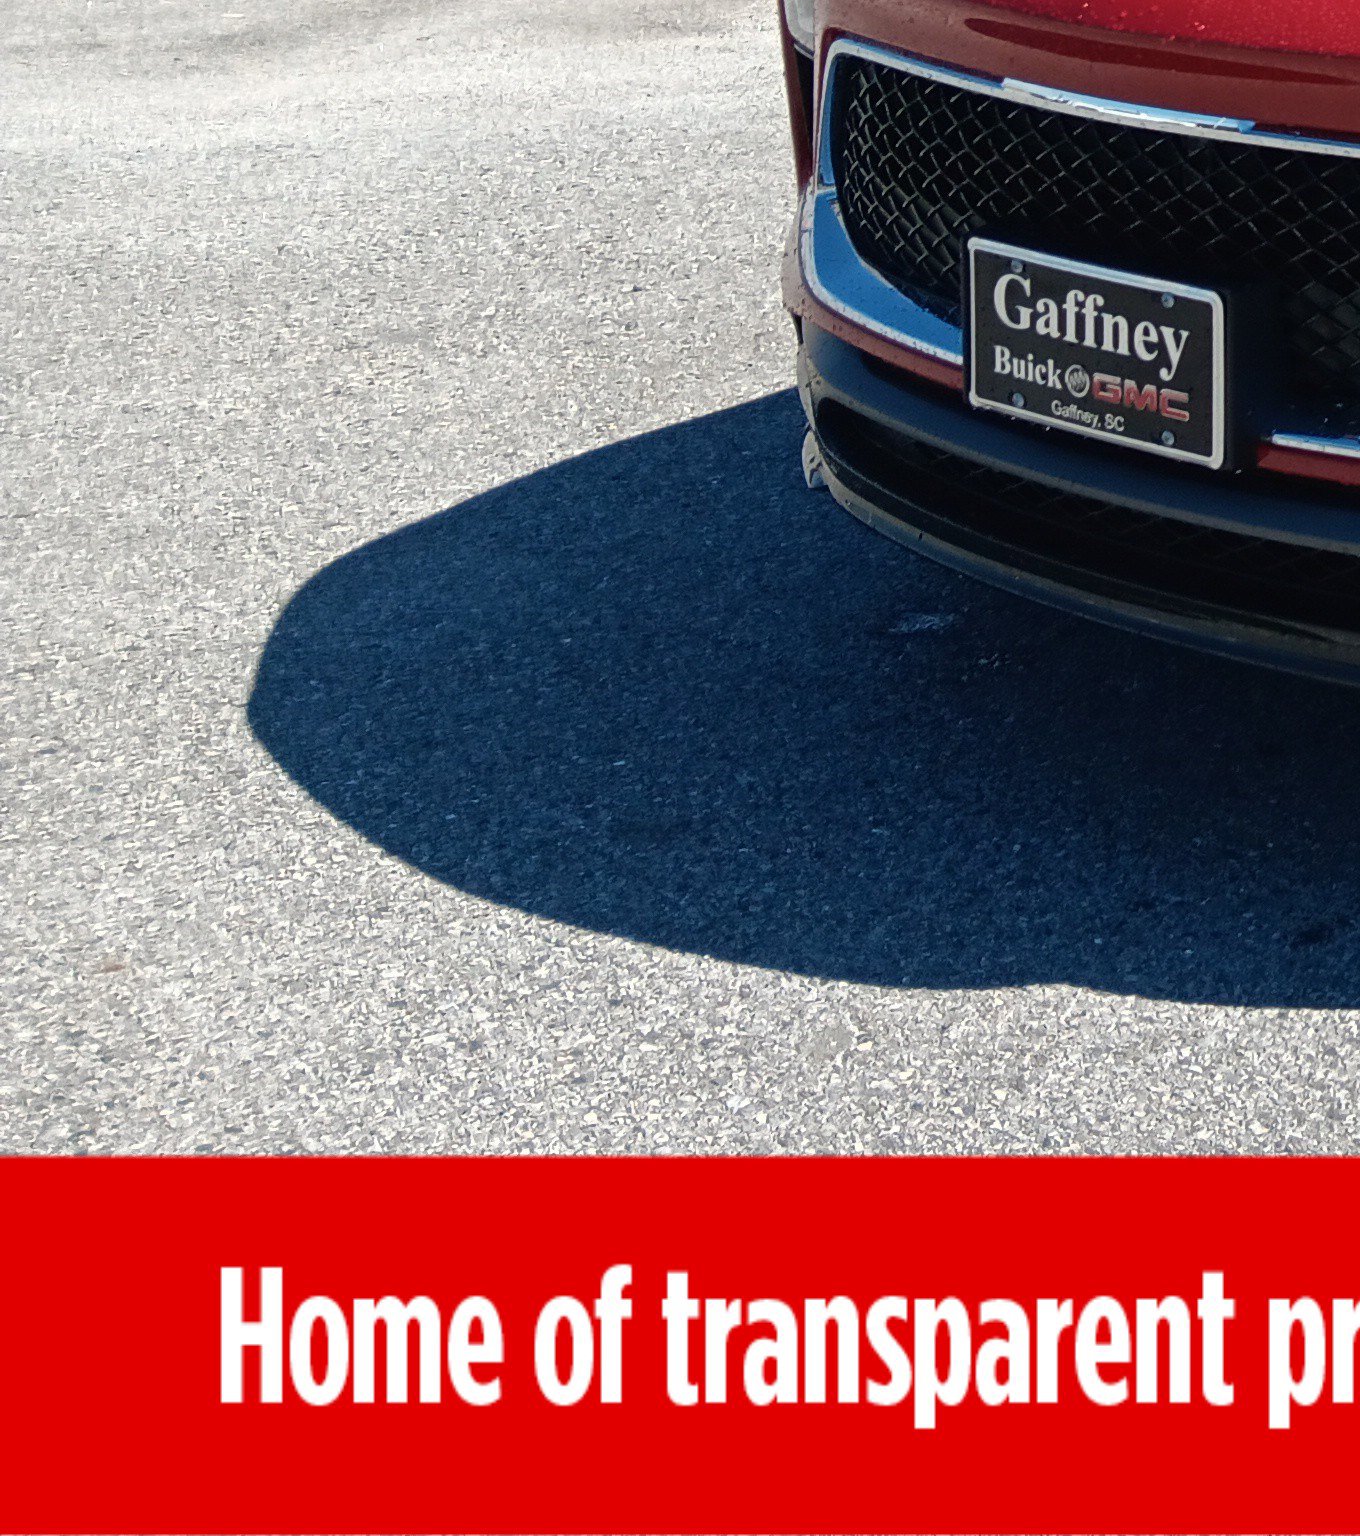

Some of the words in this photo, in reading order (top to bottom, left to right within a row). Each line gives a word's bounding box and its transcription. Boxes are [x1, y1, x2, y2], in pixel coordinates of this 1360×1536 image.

[993, 273, 1190, 382] Gaffney
[993, 344, 1063, 390] Buick
[1091, 371, 1190, 423] GMC
[1104, 412, 1125, 433] SC
